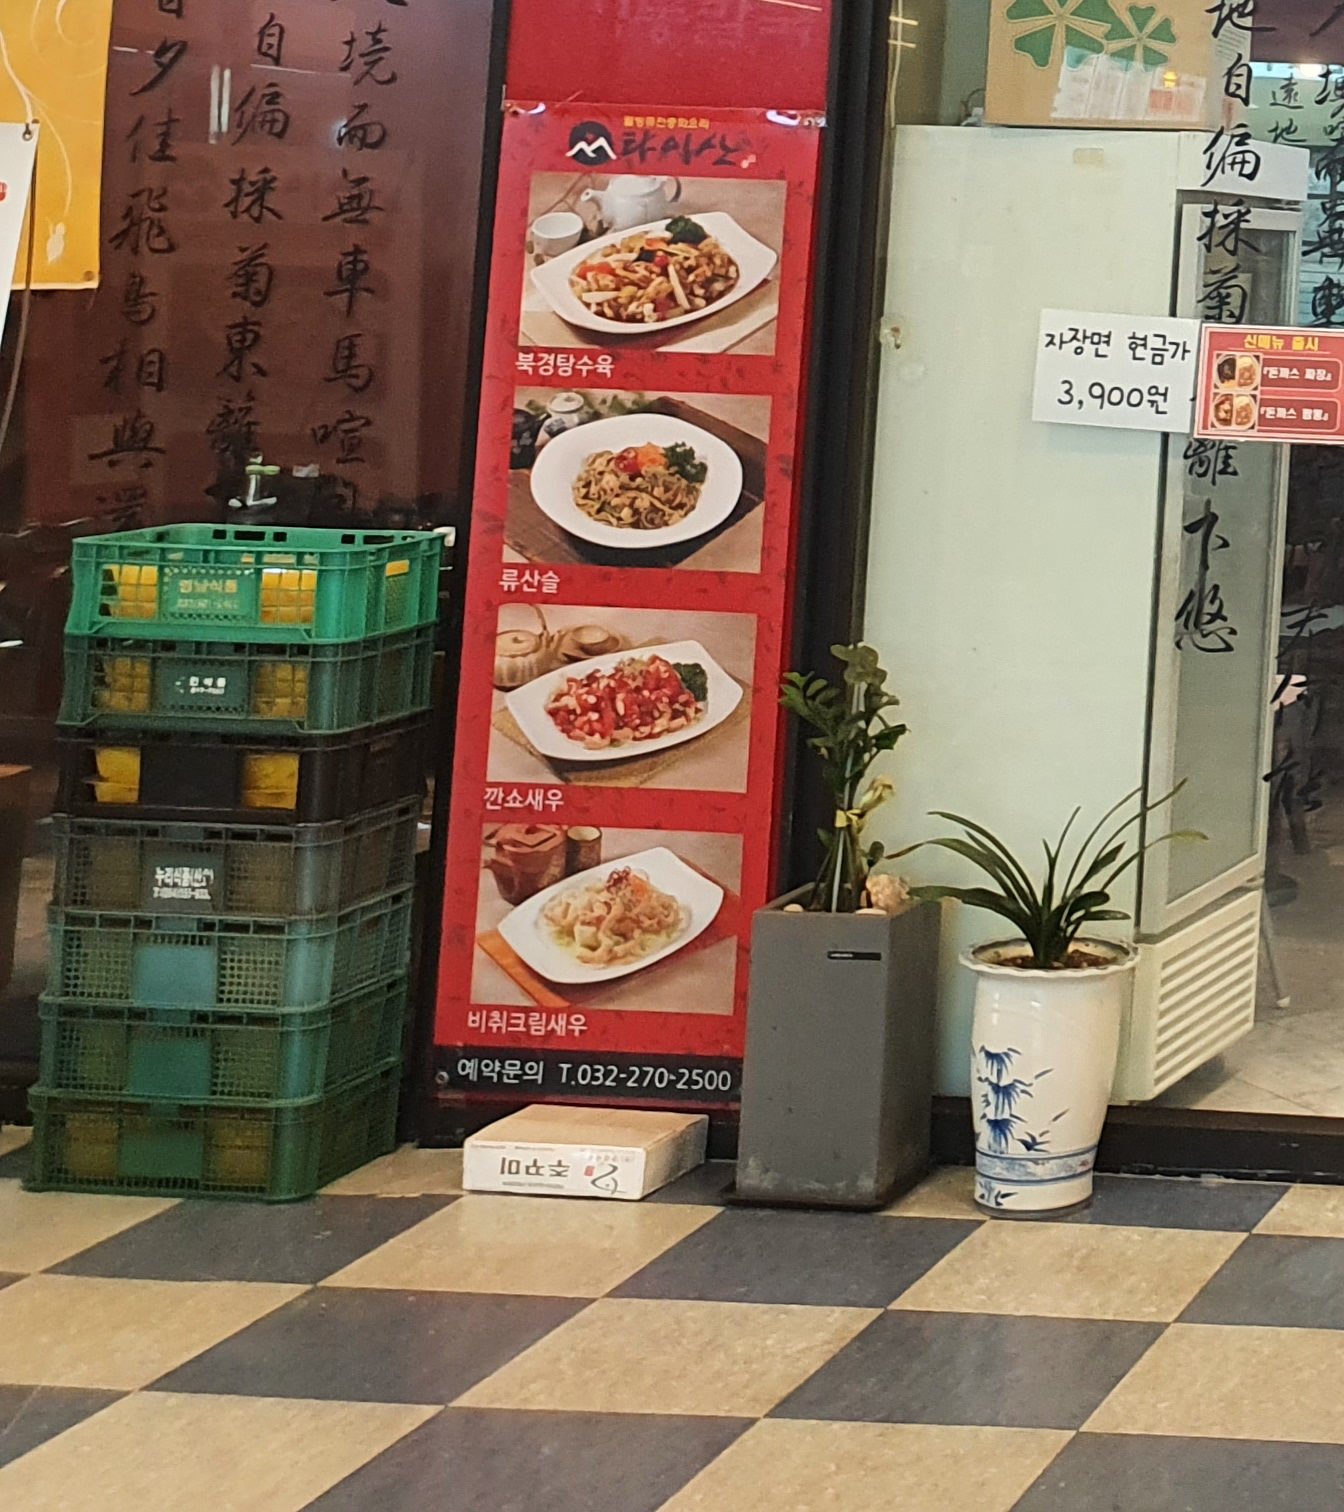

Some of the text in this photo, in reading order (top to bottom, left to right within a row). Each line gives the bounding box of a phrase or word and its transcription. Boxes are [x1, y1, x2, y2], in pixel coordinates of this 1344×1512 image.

[621, 129, 749, 165] 타이산
[1044, 327, 1191, 366] 자장면 현금가
[1243, 334, 1320, 352] 신메뉴 출시
[515, 351, 616, 379] 북경탕수육
[1056, 379, 1169, 415] 3,900원
[498, 568, 561, 595] 류산슬
[484, 785, 565, 813] 깐쇼새우
[467, 1010, 588, 1039] 비취크림새우
[457, 1058, 732, 1092] 예약문의 T.032-270-2500
